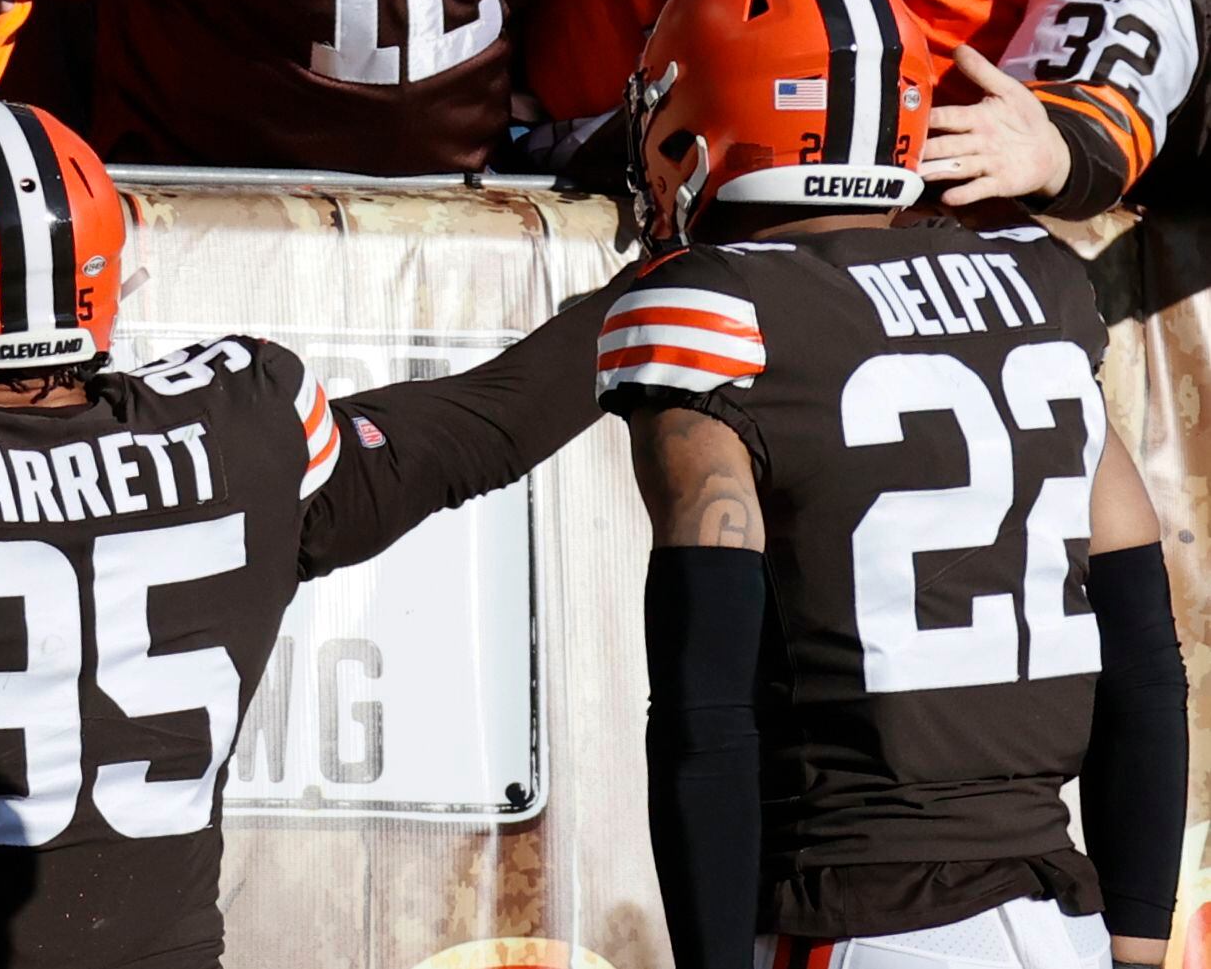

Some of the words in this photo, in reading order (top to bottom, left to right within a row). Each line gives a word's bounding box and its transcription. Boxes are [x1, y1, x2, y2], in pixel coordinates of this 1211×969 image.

[1034, 1, 1161, 110] 32
[804, 176, 905, 200] CLEVELAND
[78, 287, 95, 322] 5
[847, 253, 1046, 338] DELPIT
[840, 340, 1108, 693] 22
[236, 634, 384, 784] WG
